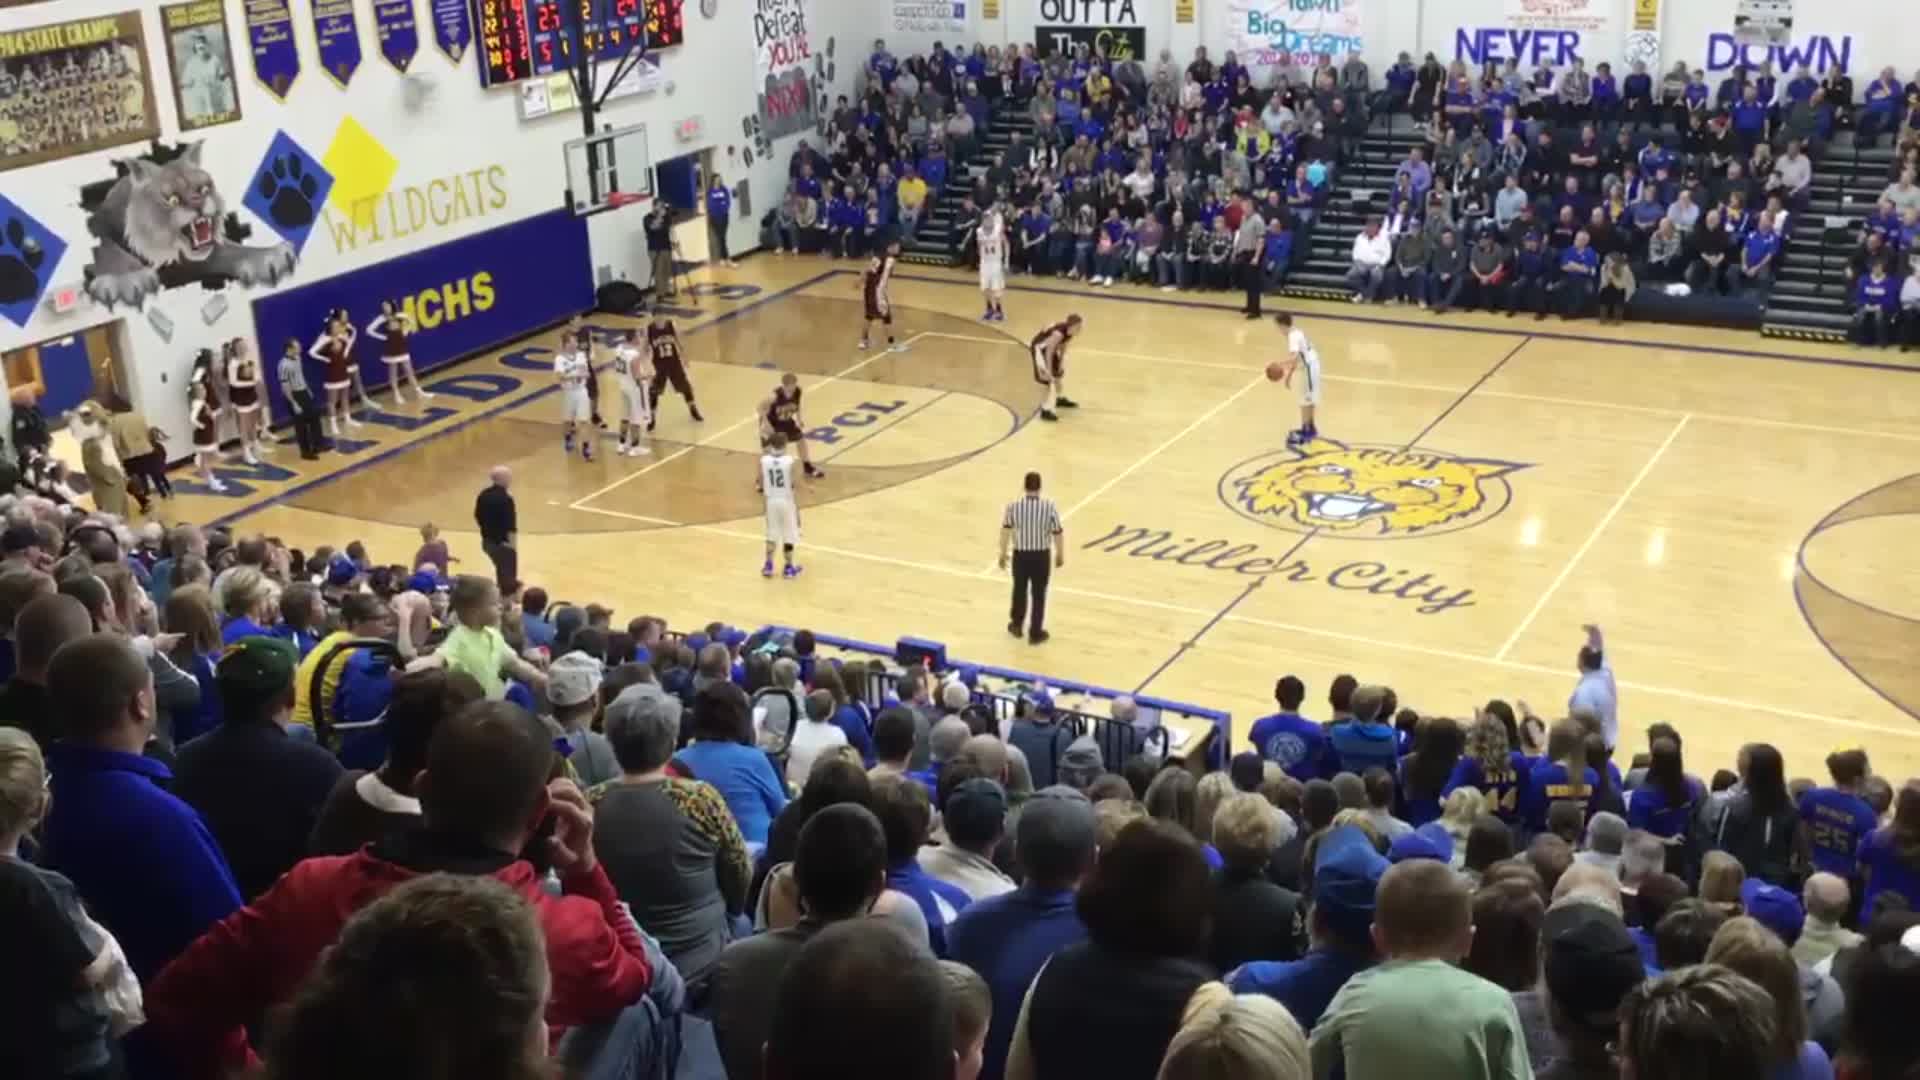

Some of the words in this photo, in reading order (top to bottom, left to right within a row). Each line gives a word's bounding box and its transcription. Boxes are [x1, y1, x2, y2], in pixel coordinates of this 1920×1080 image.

[323, 164, 508, 255] WILDCATS
[802, 399, 908, 445] PCL
[767, 468, 786, 489] 12
[1081, 523, 1318, 583] Miller
[1326, 560, 1477, 614] City
